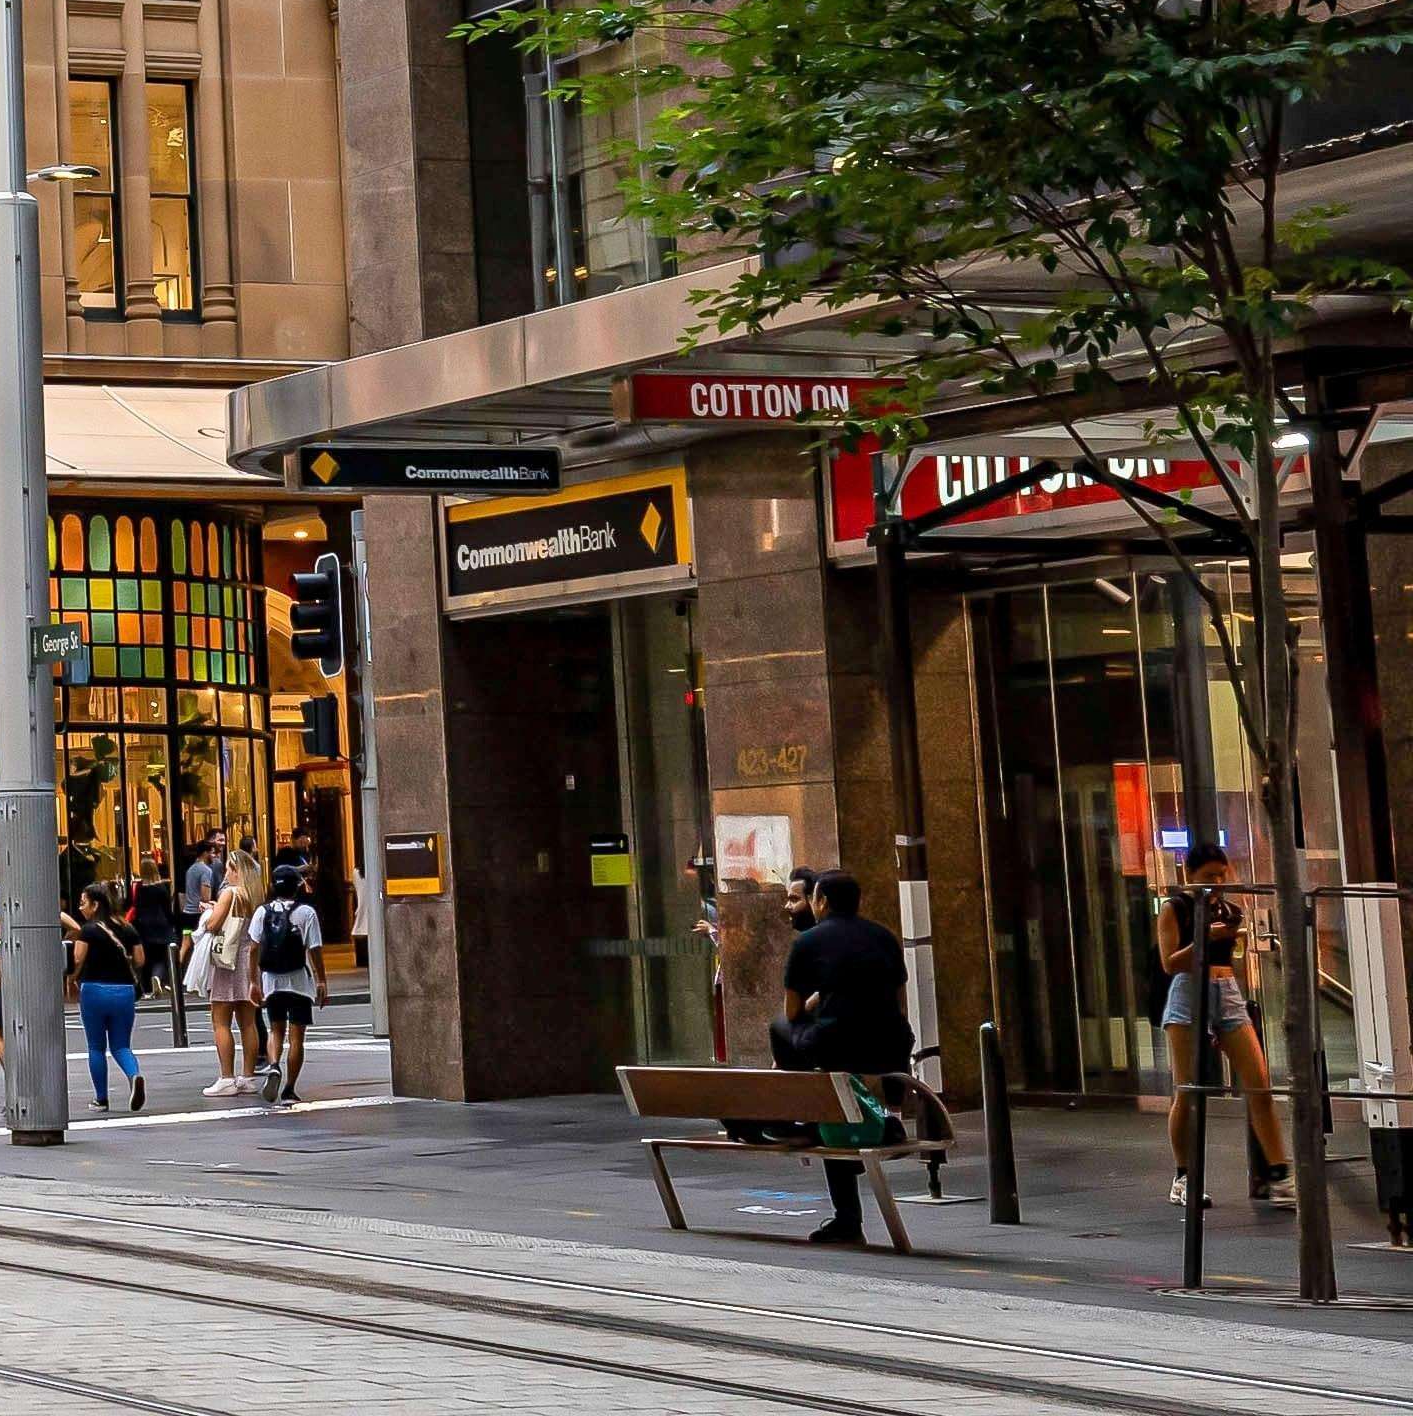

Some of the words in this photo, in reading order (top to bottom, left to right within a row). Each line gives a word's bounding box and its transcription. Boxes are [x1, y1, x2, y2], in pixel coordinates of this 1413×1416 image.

[690, 382, 802, 418] COTTON
[811, 384, 850, 414] ON
[405, 465, 550, 481] CommonwealthBank
[456, 520, 617, 572] CommonwealthBank
[42, 634, 69, 657] George
[70, 630, 79, 650] St
